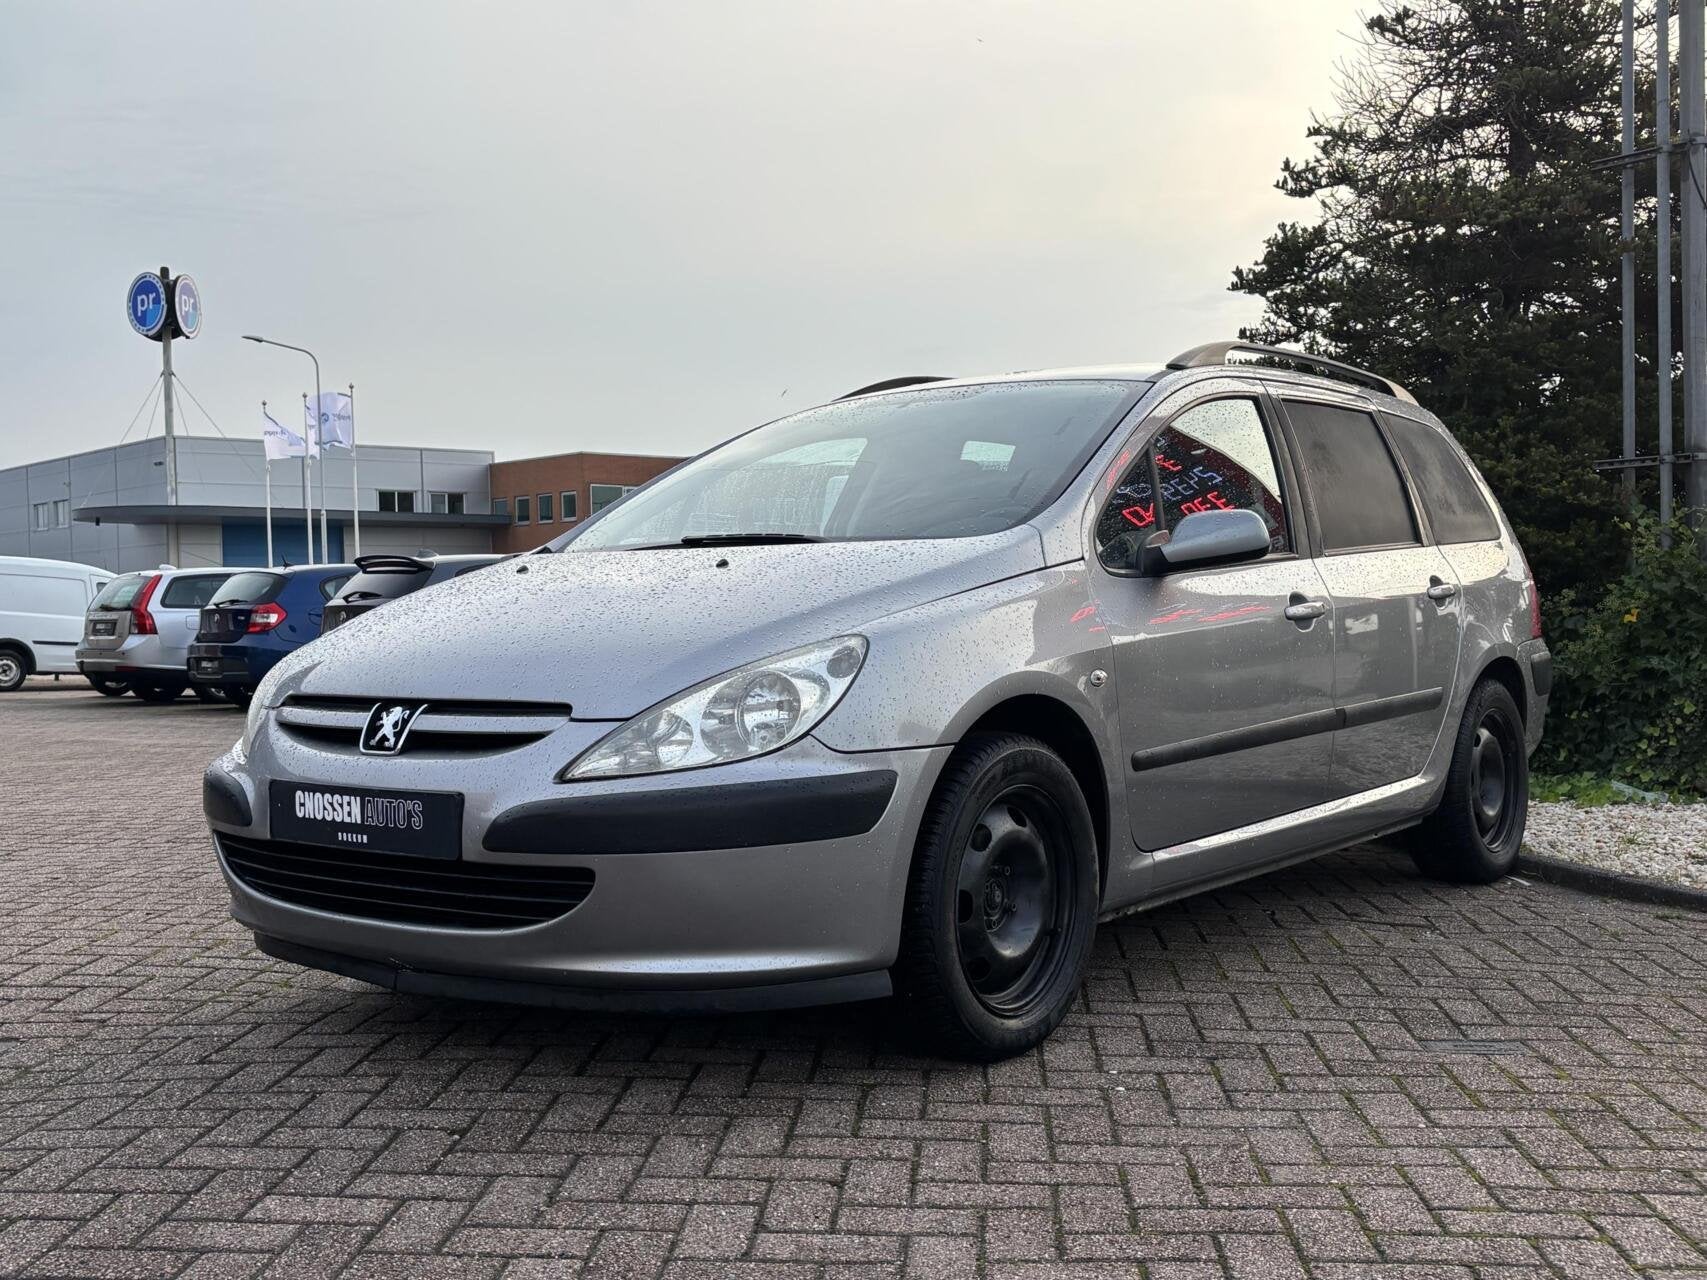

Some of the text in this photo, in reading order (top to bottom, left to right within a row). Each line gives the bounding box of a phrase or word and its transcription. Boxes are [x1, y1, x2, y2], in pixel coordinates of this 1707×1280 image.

[137, 292, 156, 317] pr
[181, 295, 194, 315] pr
[295, 790, 424, 830] CNOSSEN AUTO'S
